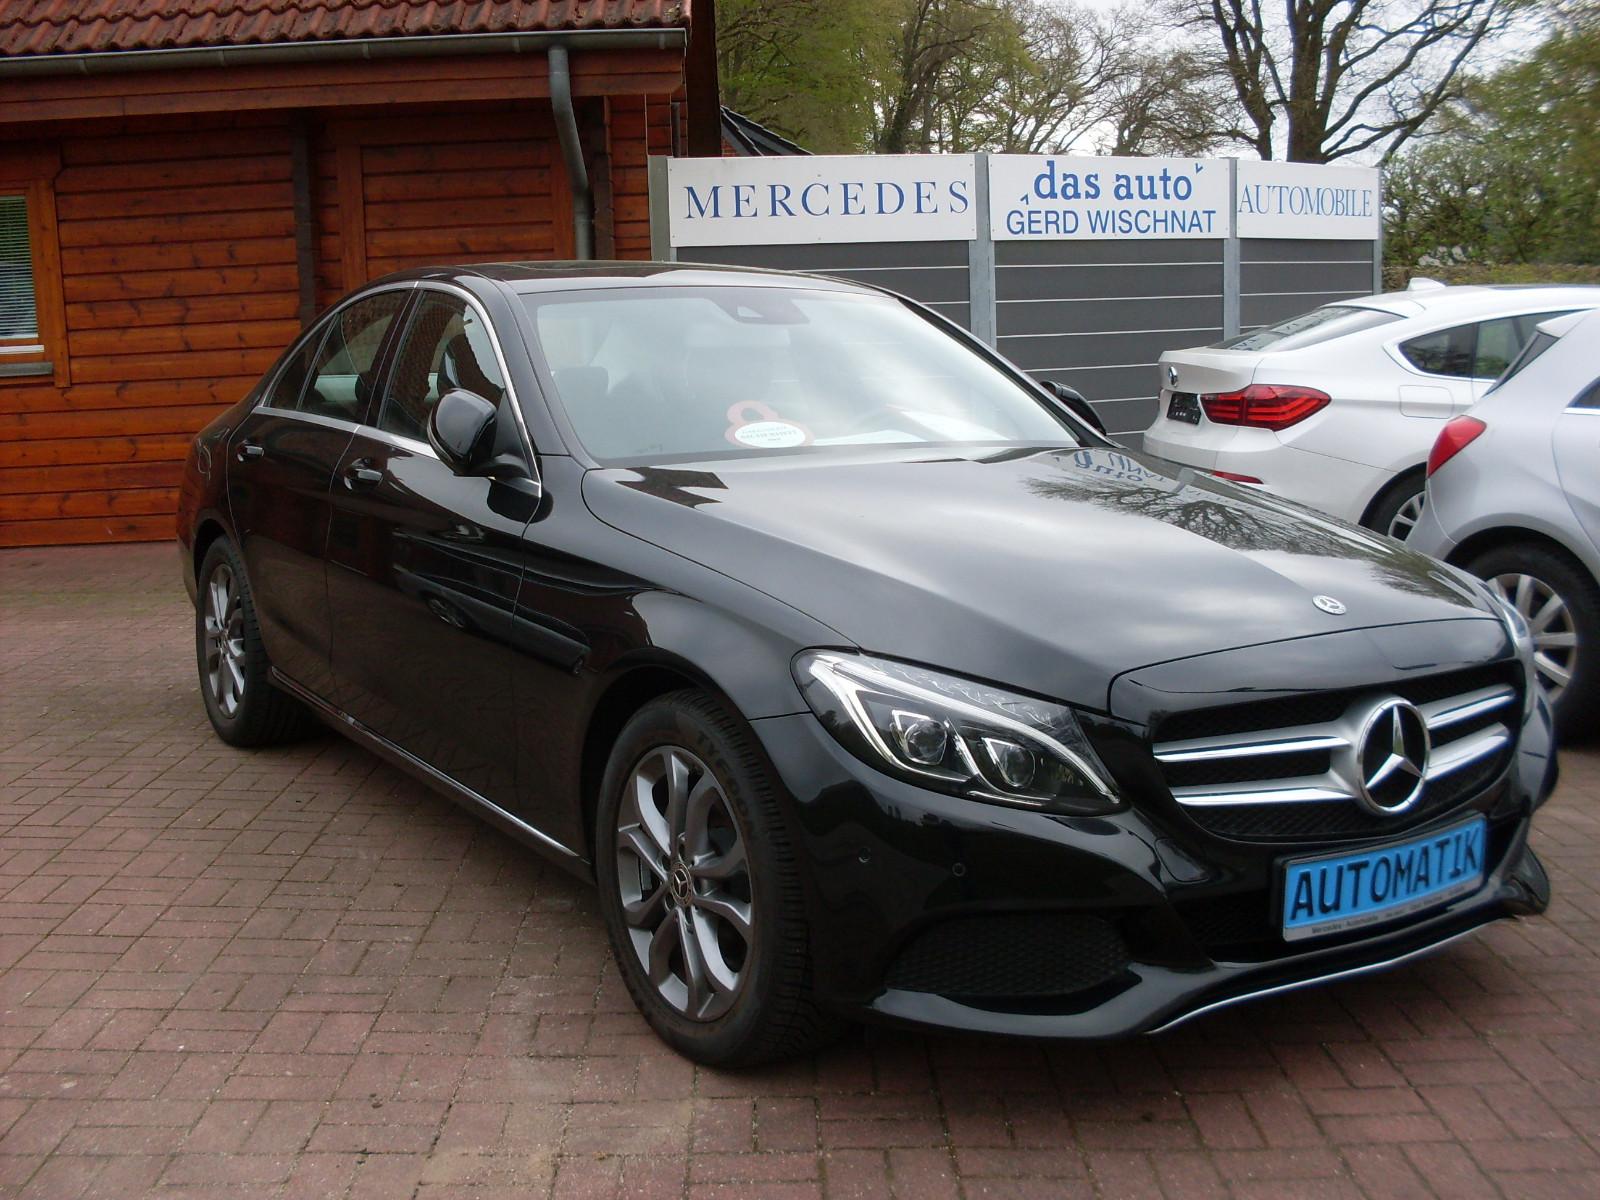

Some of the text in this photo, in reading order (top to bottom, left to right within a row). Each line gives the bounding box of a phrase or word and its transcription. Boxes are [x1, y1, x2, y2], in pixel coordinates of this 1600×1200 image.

[683, 180, 969, 219] MERCEDES
[1034, 160, 1192, 201] das auto
[1237, 184, 1373, 217] AUTOMOBILE
[1006, 209, 1217, 236] GERD WISCHNAT
[1290, 826, 1480, 921] AUTOMATIK
